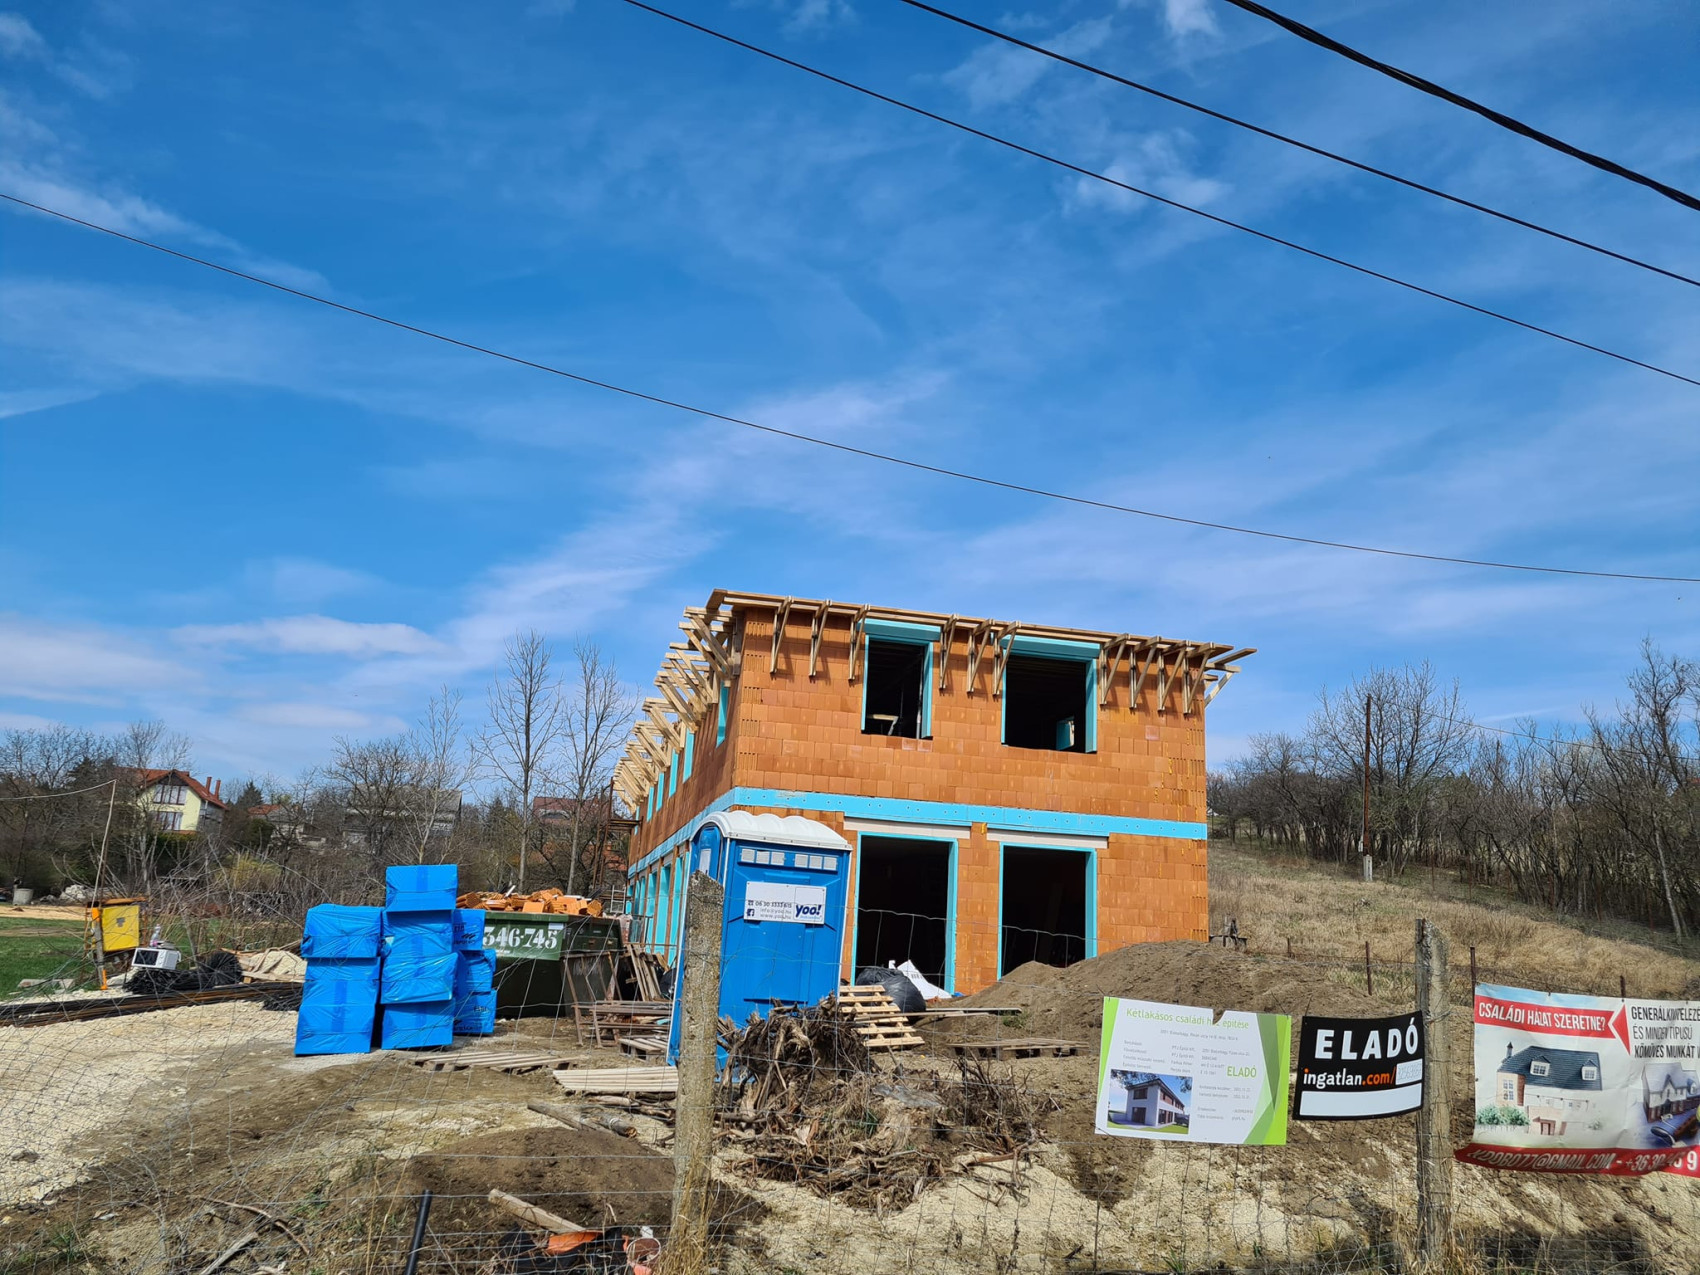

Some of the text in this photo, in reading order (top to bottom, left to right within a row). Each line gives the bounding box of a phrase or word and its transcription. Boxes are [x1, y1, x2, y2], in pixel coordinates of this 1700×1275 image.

[795, 904, 822, 917] yoo!
[1478, 1002, 1525, 1024] CSALÁDI
[1554, 1013, 1606, 1031] SZERETNE?
[1315, 1017, 1418, 1060] ELADÓ
[1633, 1024, 1644, 1040] ÉS
[1226, 1065, 1257, 1078] ELADÓ
